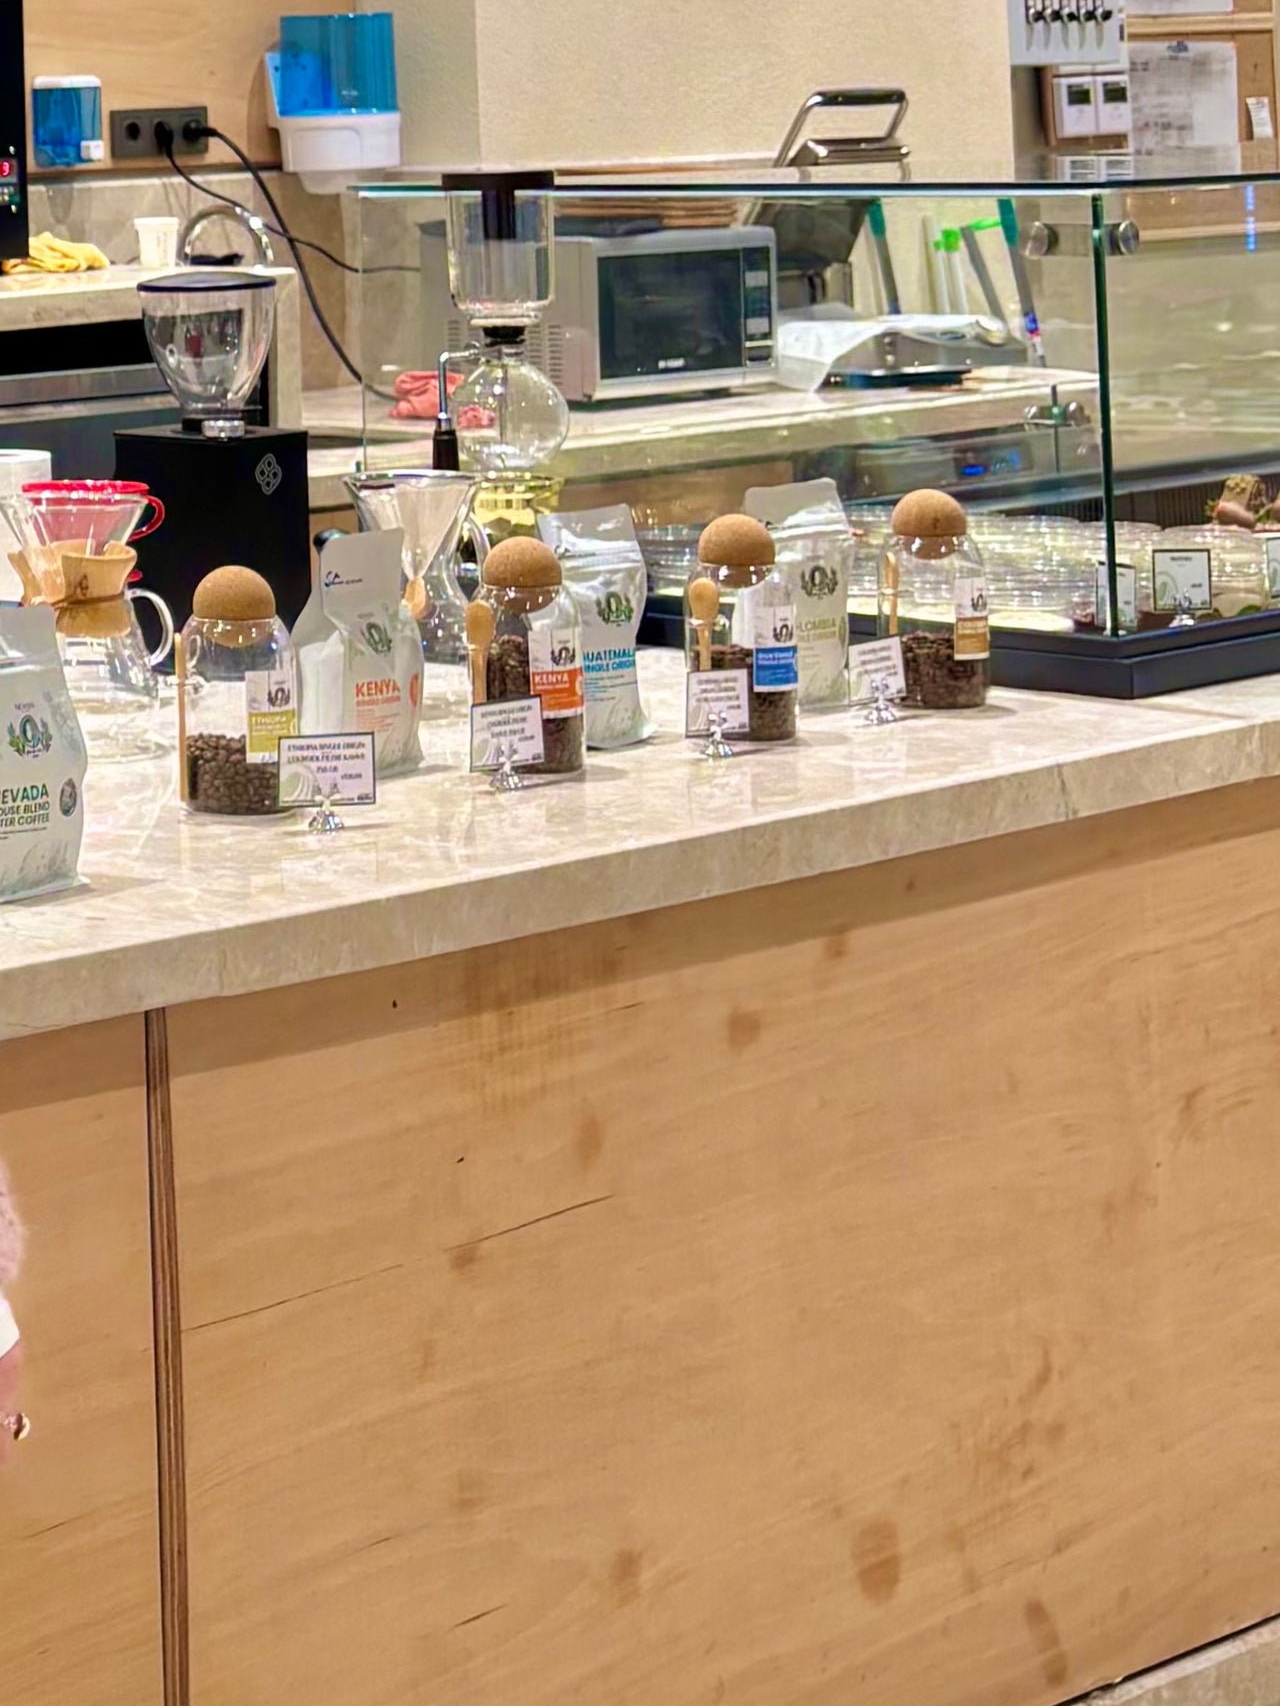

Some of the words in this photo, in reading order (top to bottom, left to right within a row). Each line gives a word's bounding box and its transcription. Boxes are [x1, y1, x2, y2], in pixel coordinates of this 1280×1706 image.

[355, 678, 401, 698] KENYA
[23, 801, 50, 814] BLEND
[17, 812, 50, 826] COFFEE
